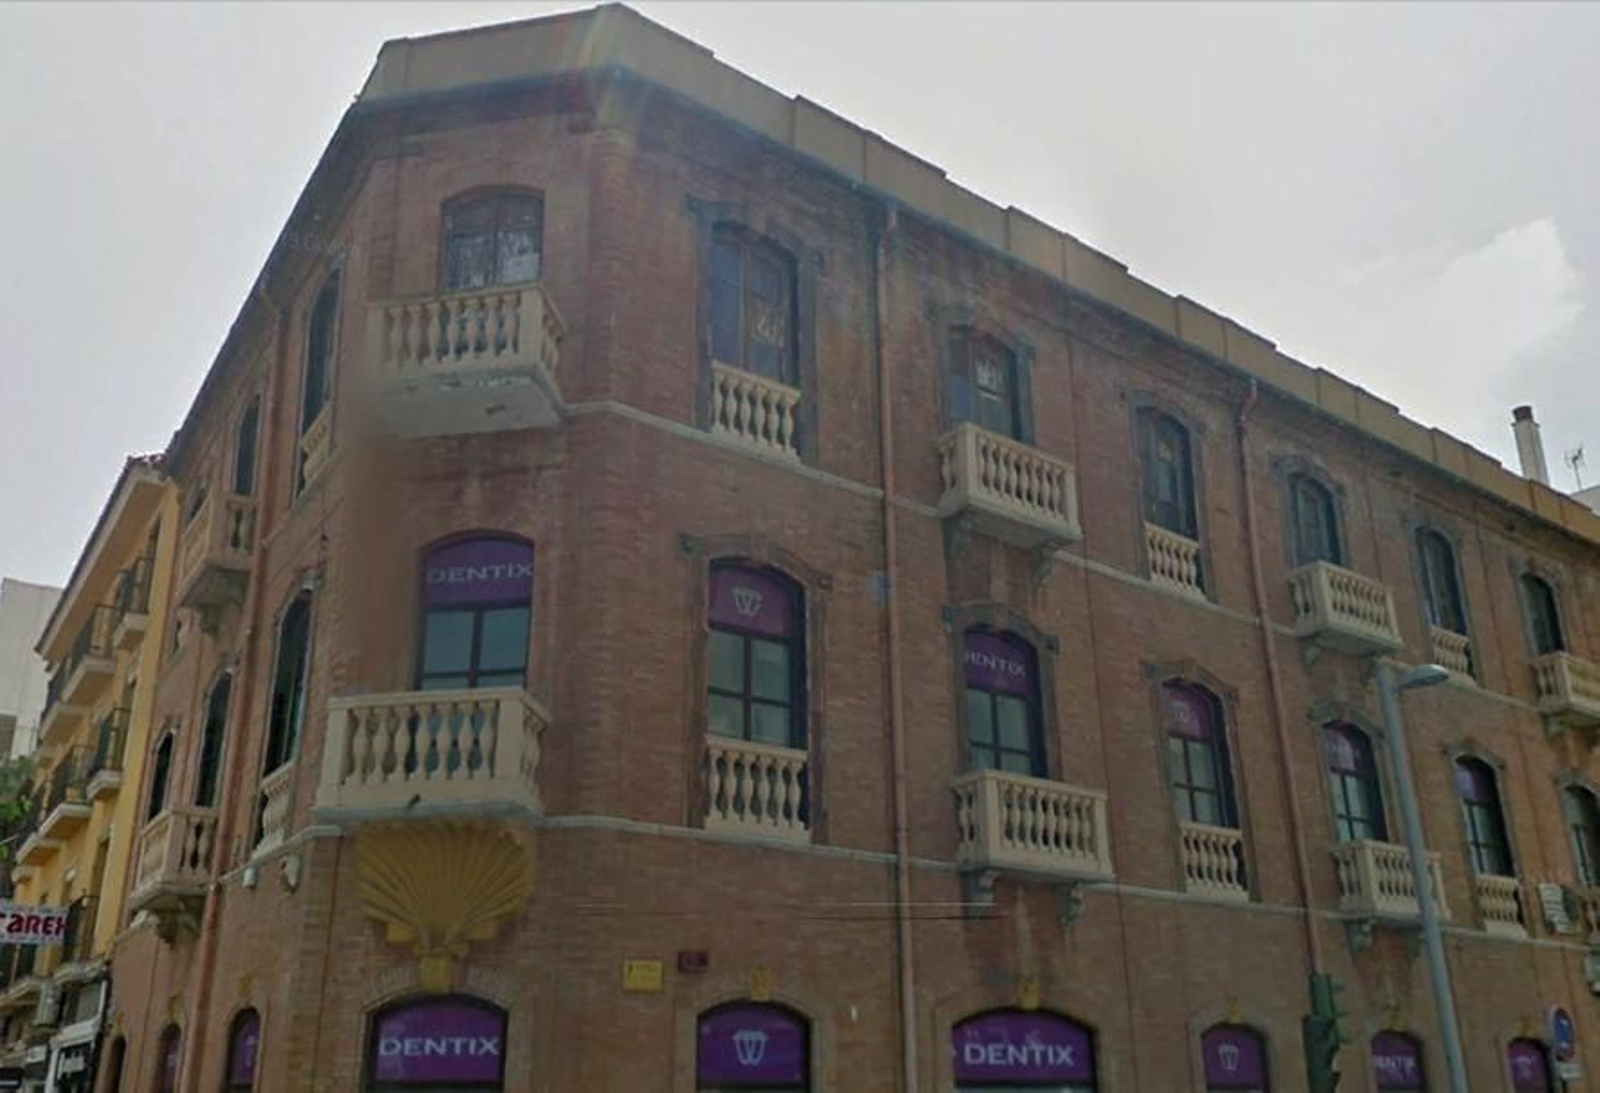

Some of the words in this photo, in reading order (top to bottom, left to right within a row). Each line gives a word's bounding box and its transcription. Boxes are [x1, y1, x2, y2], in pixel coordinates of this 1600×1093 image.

[426, 562, 533, 584] DENTIX
[379, 1036, 499, 1056] DENTIX
[964, 1042, 1074, 1067] DENTIX
